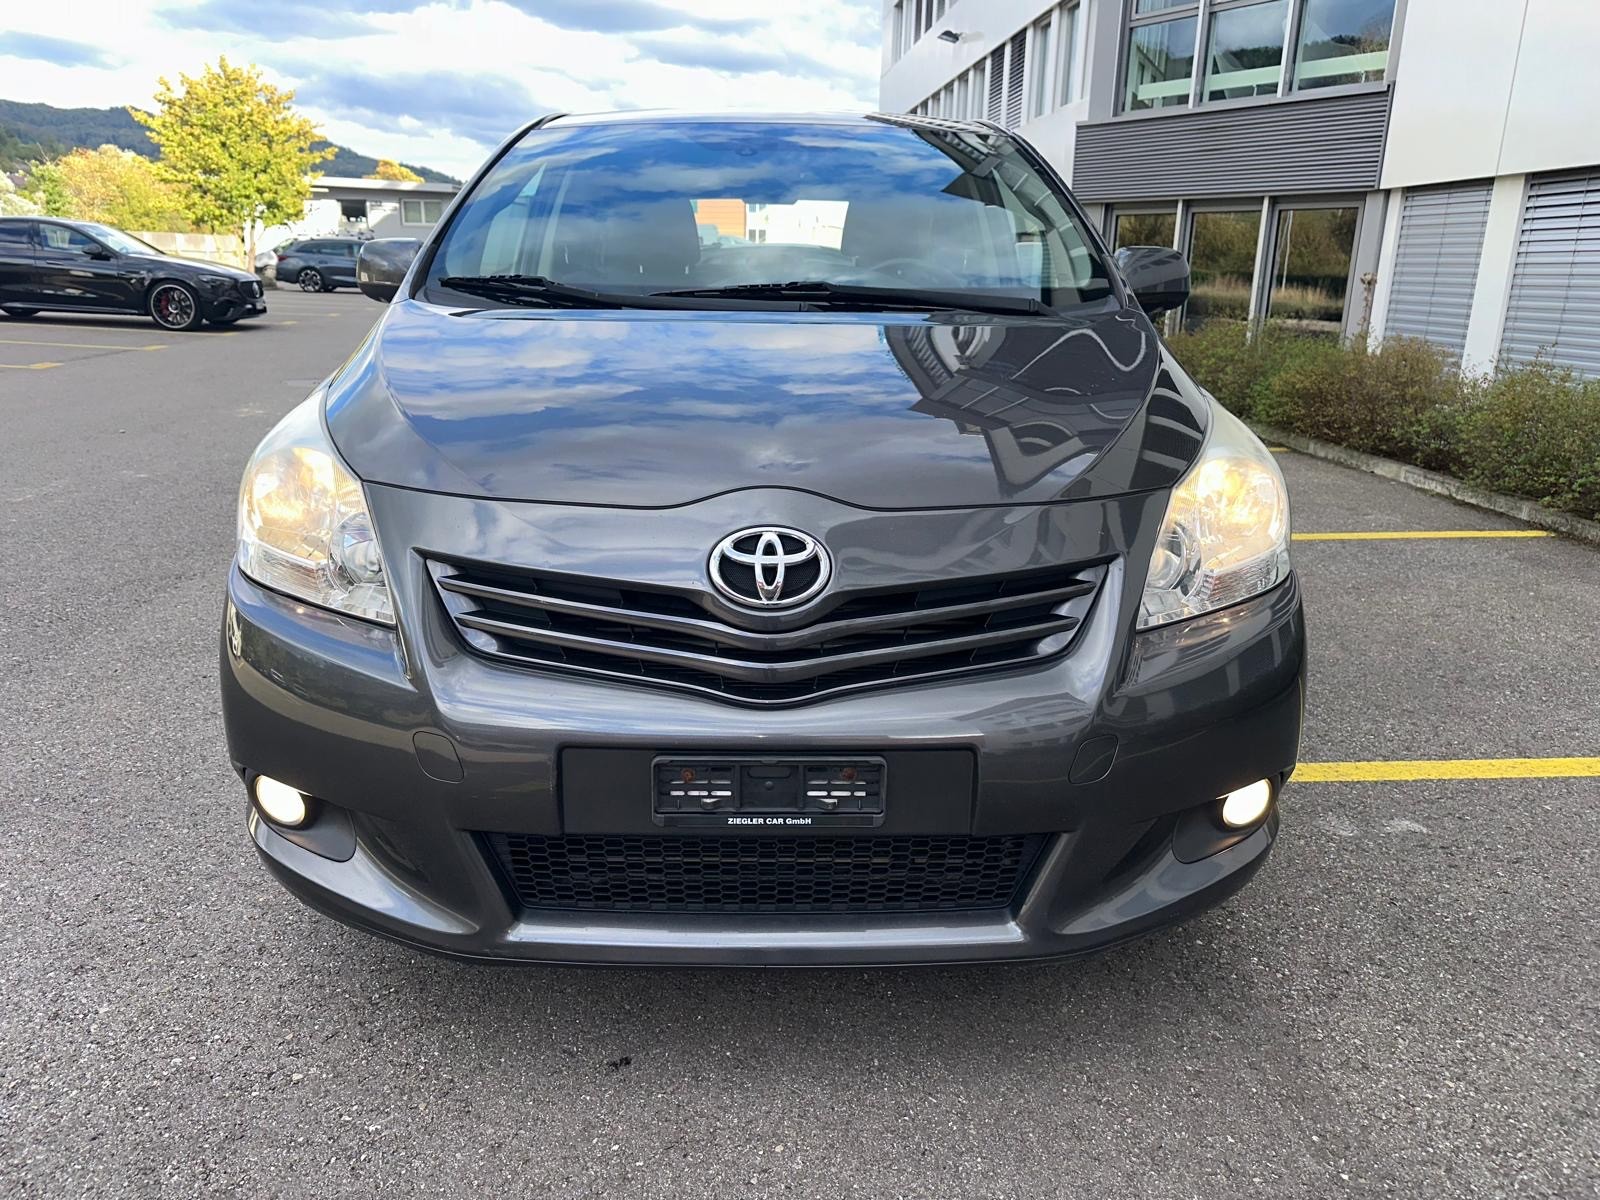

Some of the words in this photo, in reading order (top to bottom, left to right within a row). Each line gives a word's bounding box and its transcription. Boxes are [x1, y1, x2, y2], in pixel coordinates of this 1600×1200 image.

[727, 817, 764, 825] ZIEGLER
[765, 817, 784, 825] CAR
[785, 817, 812, 825] GmbH
